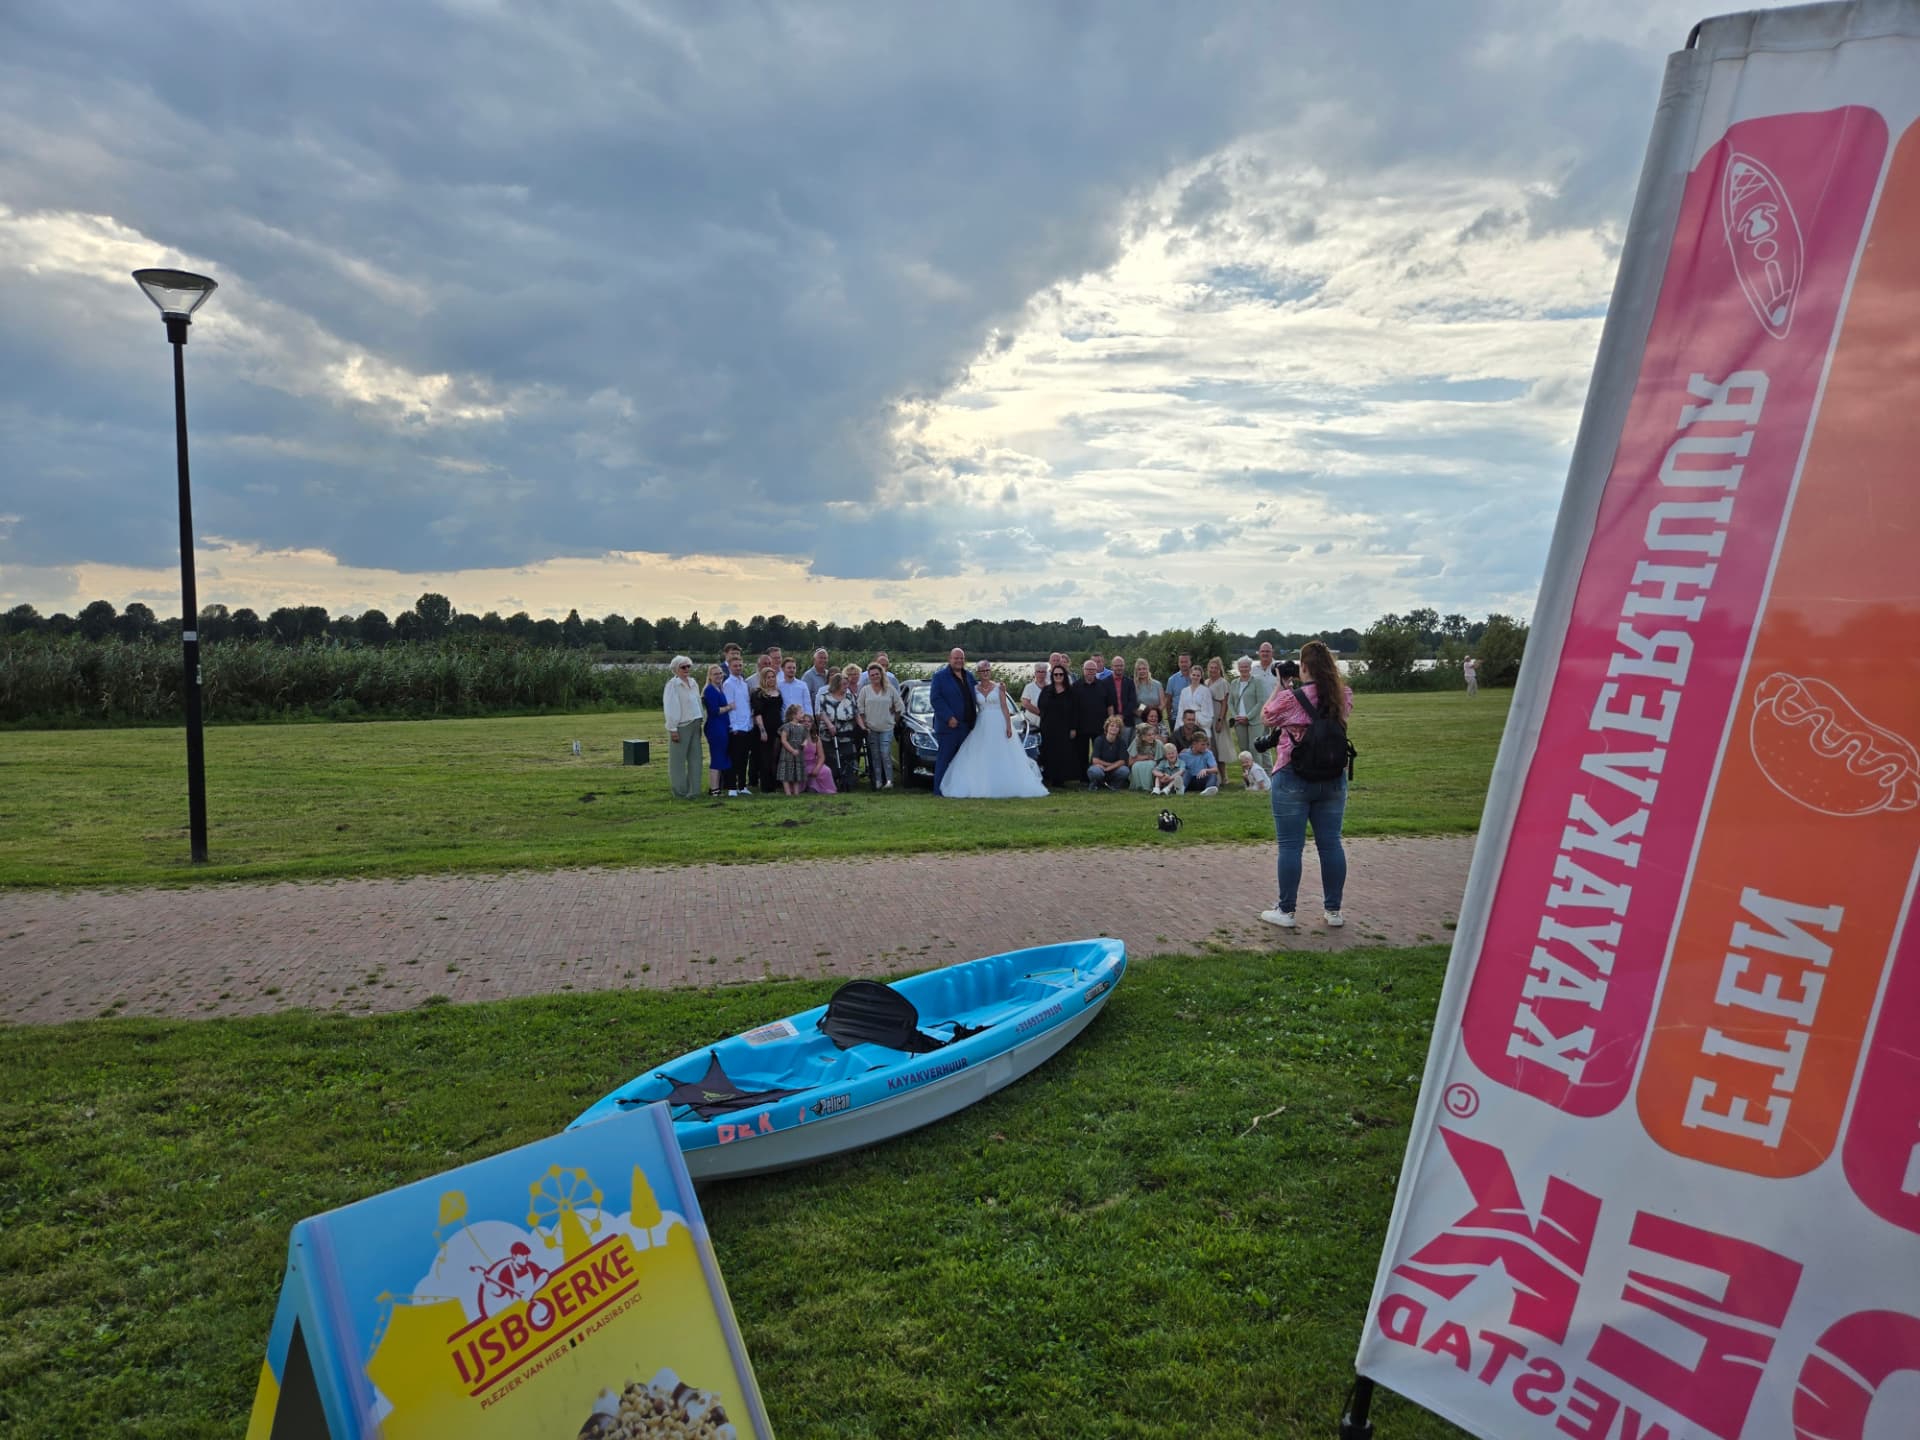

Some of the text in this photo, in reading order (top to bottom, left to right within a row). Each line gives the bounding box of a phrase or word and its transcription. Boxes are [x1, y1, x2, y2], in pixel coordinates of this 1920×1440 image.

[820, 1094, 850, 1116] Pelican
[887, 1057, 968, 1090] KAYAKVERHUUR
[452, 1244, 635, 1384] IJSBOERKE
[480, 1377, 523, 1410] PLEZIER
[523, 1362, 545, 1380] VAN
[545, 1344, 569, 1367] HIER
[585, 1306, 624, 1337] PLAISIRS
